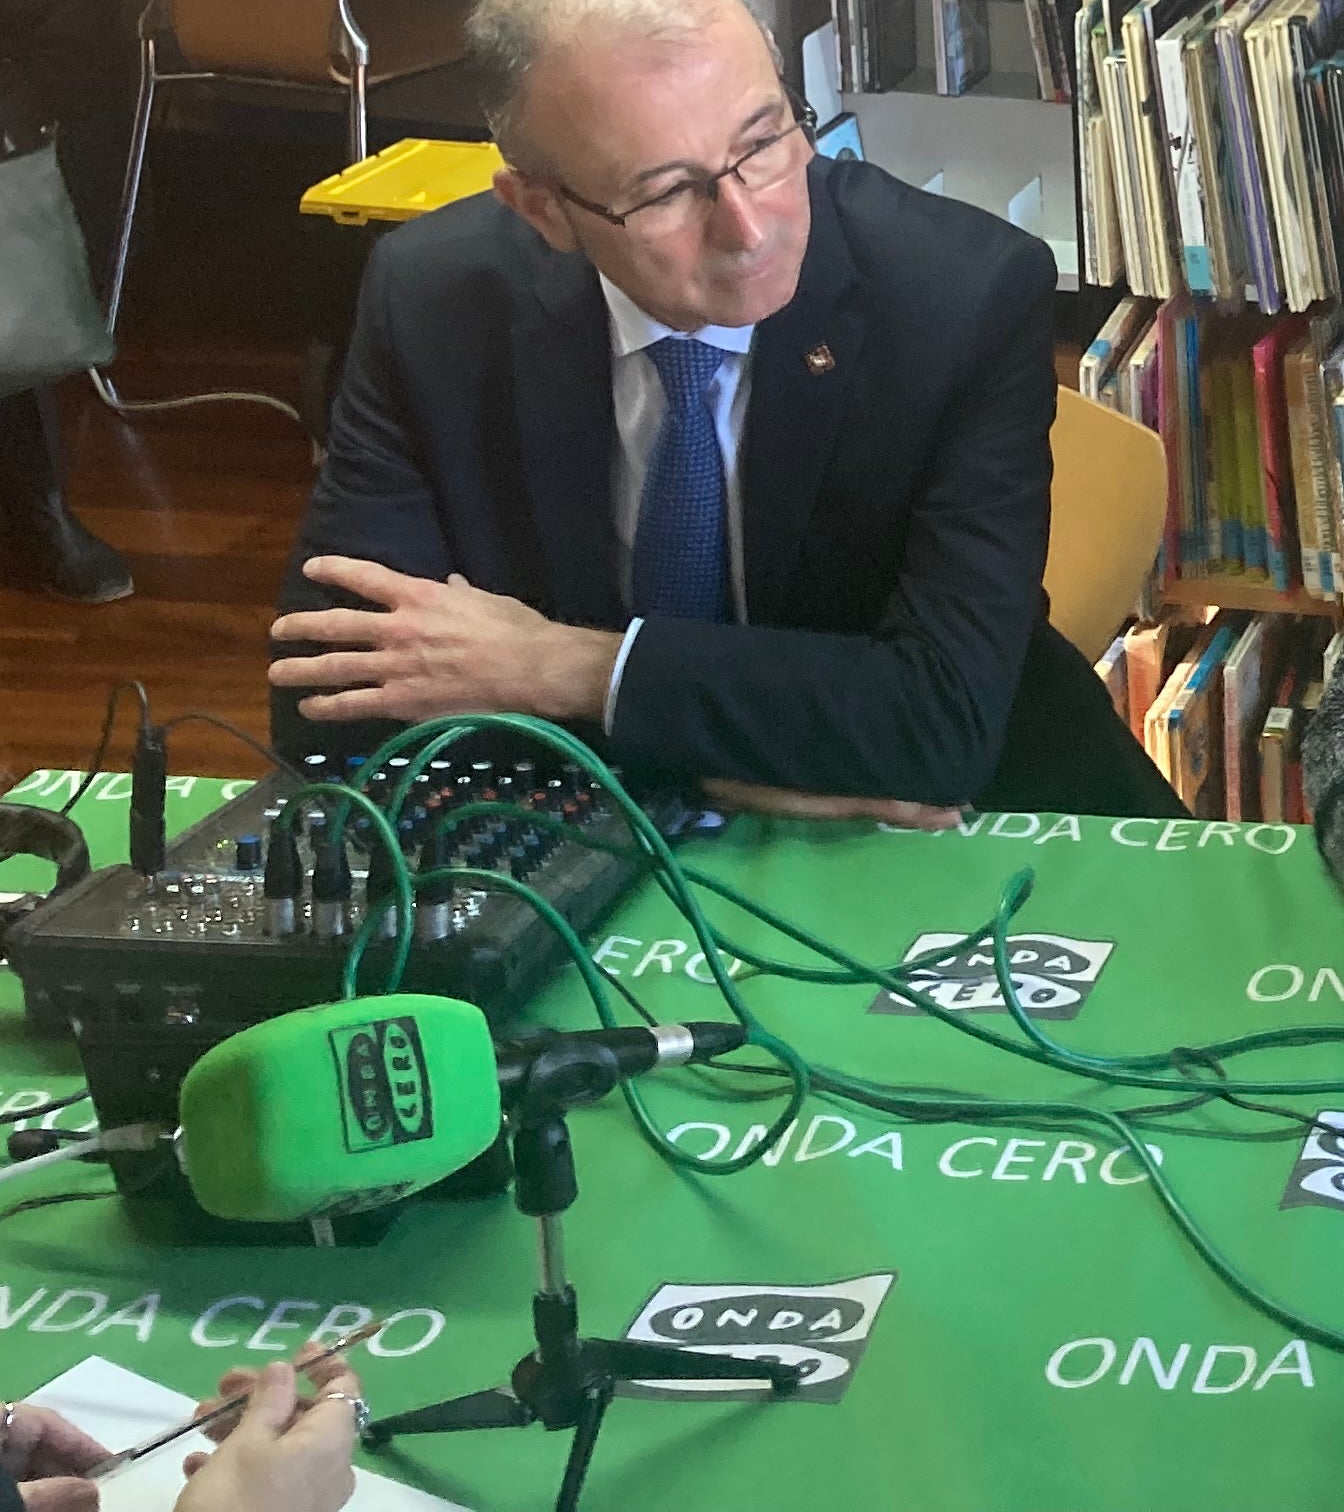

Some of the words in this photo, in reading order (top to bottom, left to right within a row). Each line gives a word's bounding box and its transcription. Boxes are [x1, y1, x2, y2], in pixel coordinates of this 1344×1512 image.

[1110, 816, 1297, 856] CERO
[598, 935, 743, 985] ERO
[938, 1135, 1163, 1187] CERO
[671, 1307, 842, 1331] ONDA
[1045, 1336, 1316, 1396] ONDA
